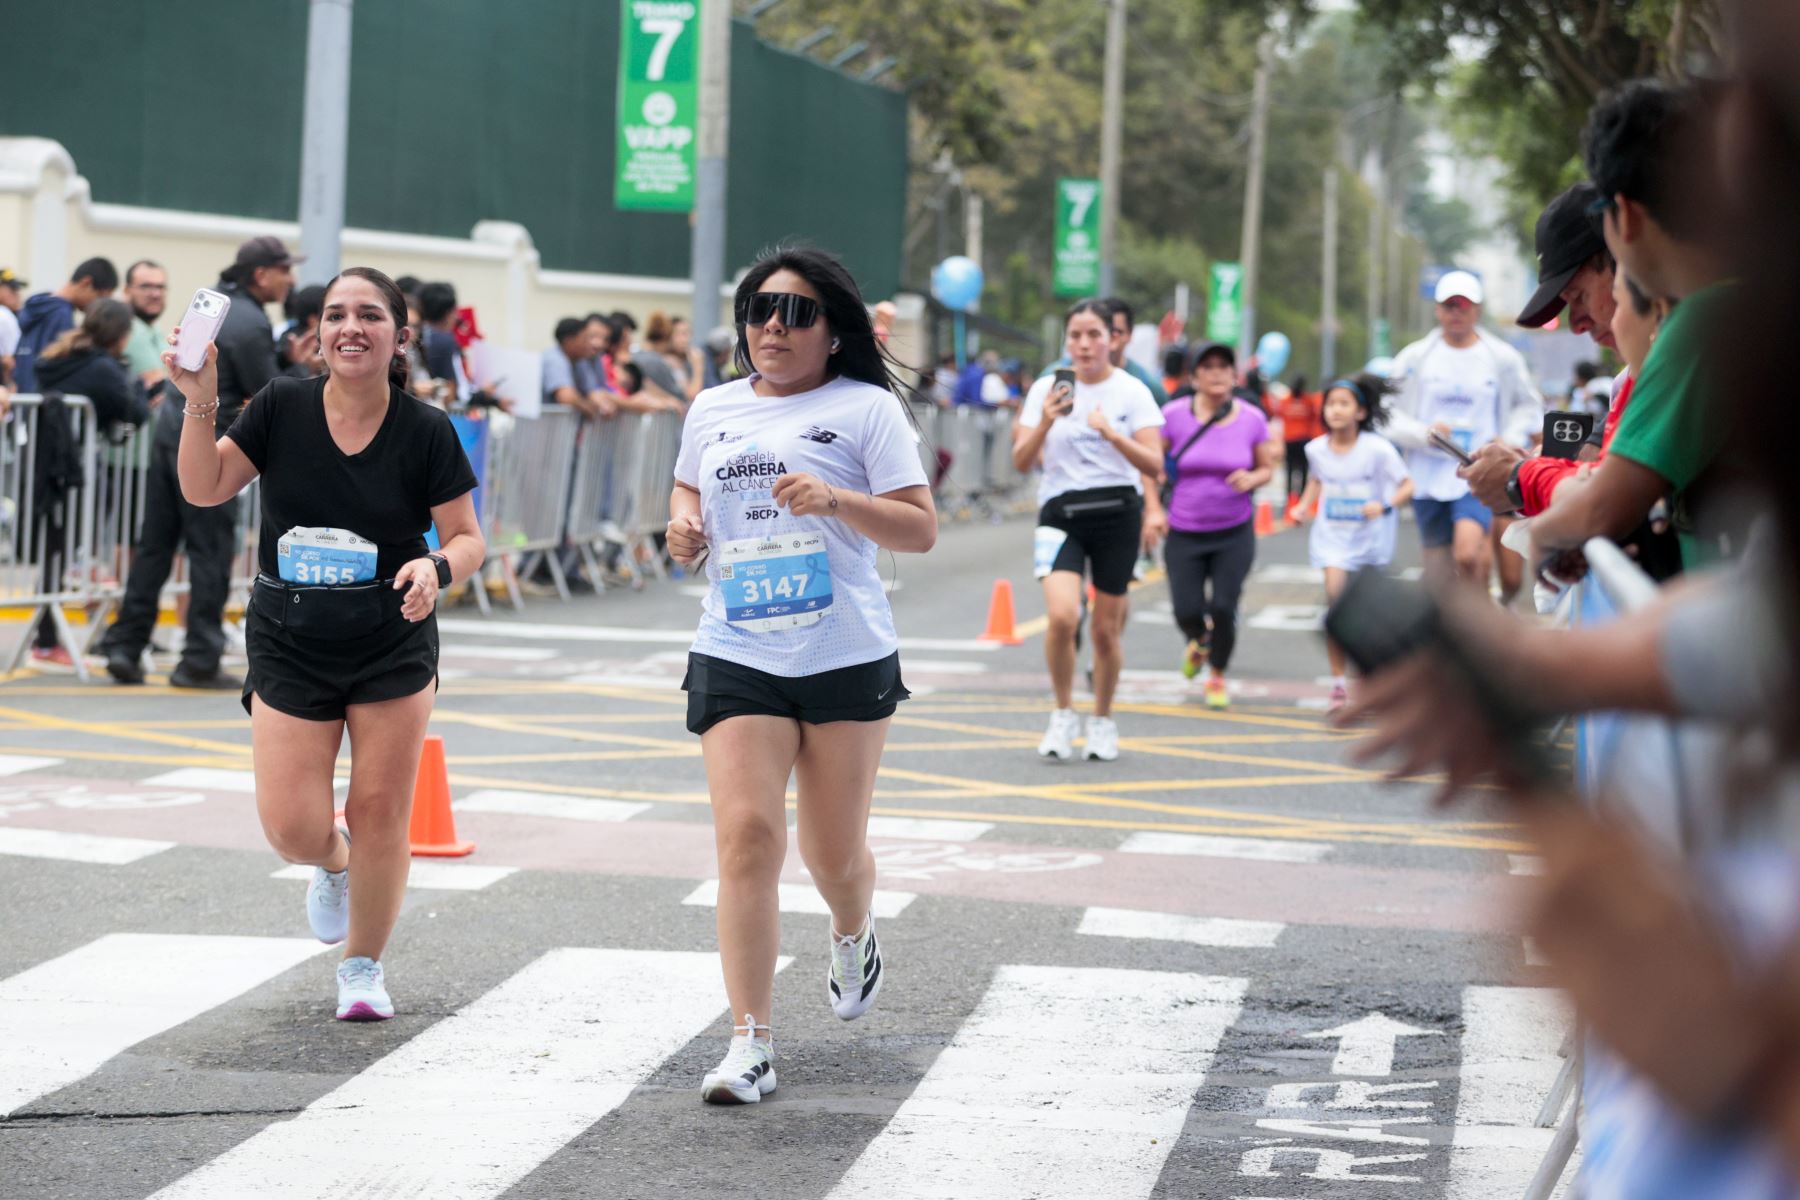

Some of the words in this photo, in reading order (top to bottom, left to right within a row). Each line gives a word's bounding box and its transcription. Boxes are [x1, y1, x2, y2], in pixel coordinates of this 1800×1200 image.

[641, 20, 684, 81] 7
[1065, 183, 1096, 227] 7
[767, 450, 776, 461] la
[716, 461, 787, 480] CARRERA
[721, 482, 738, 494] AL
[757, 544, 782, 552] CARRERA
[295, 562, 355, 585] 3155
[741, 573, 809, 603] 3147
[1229, 1080, 1440, 1200] RAR
